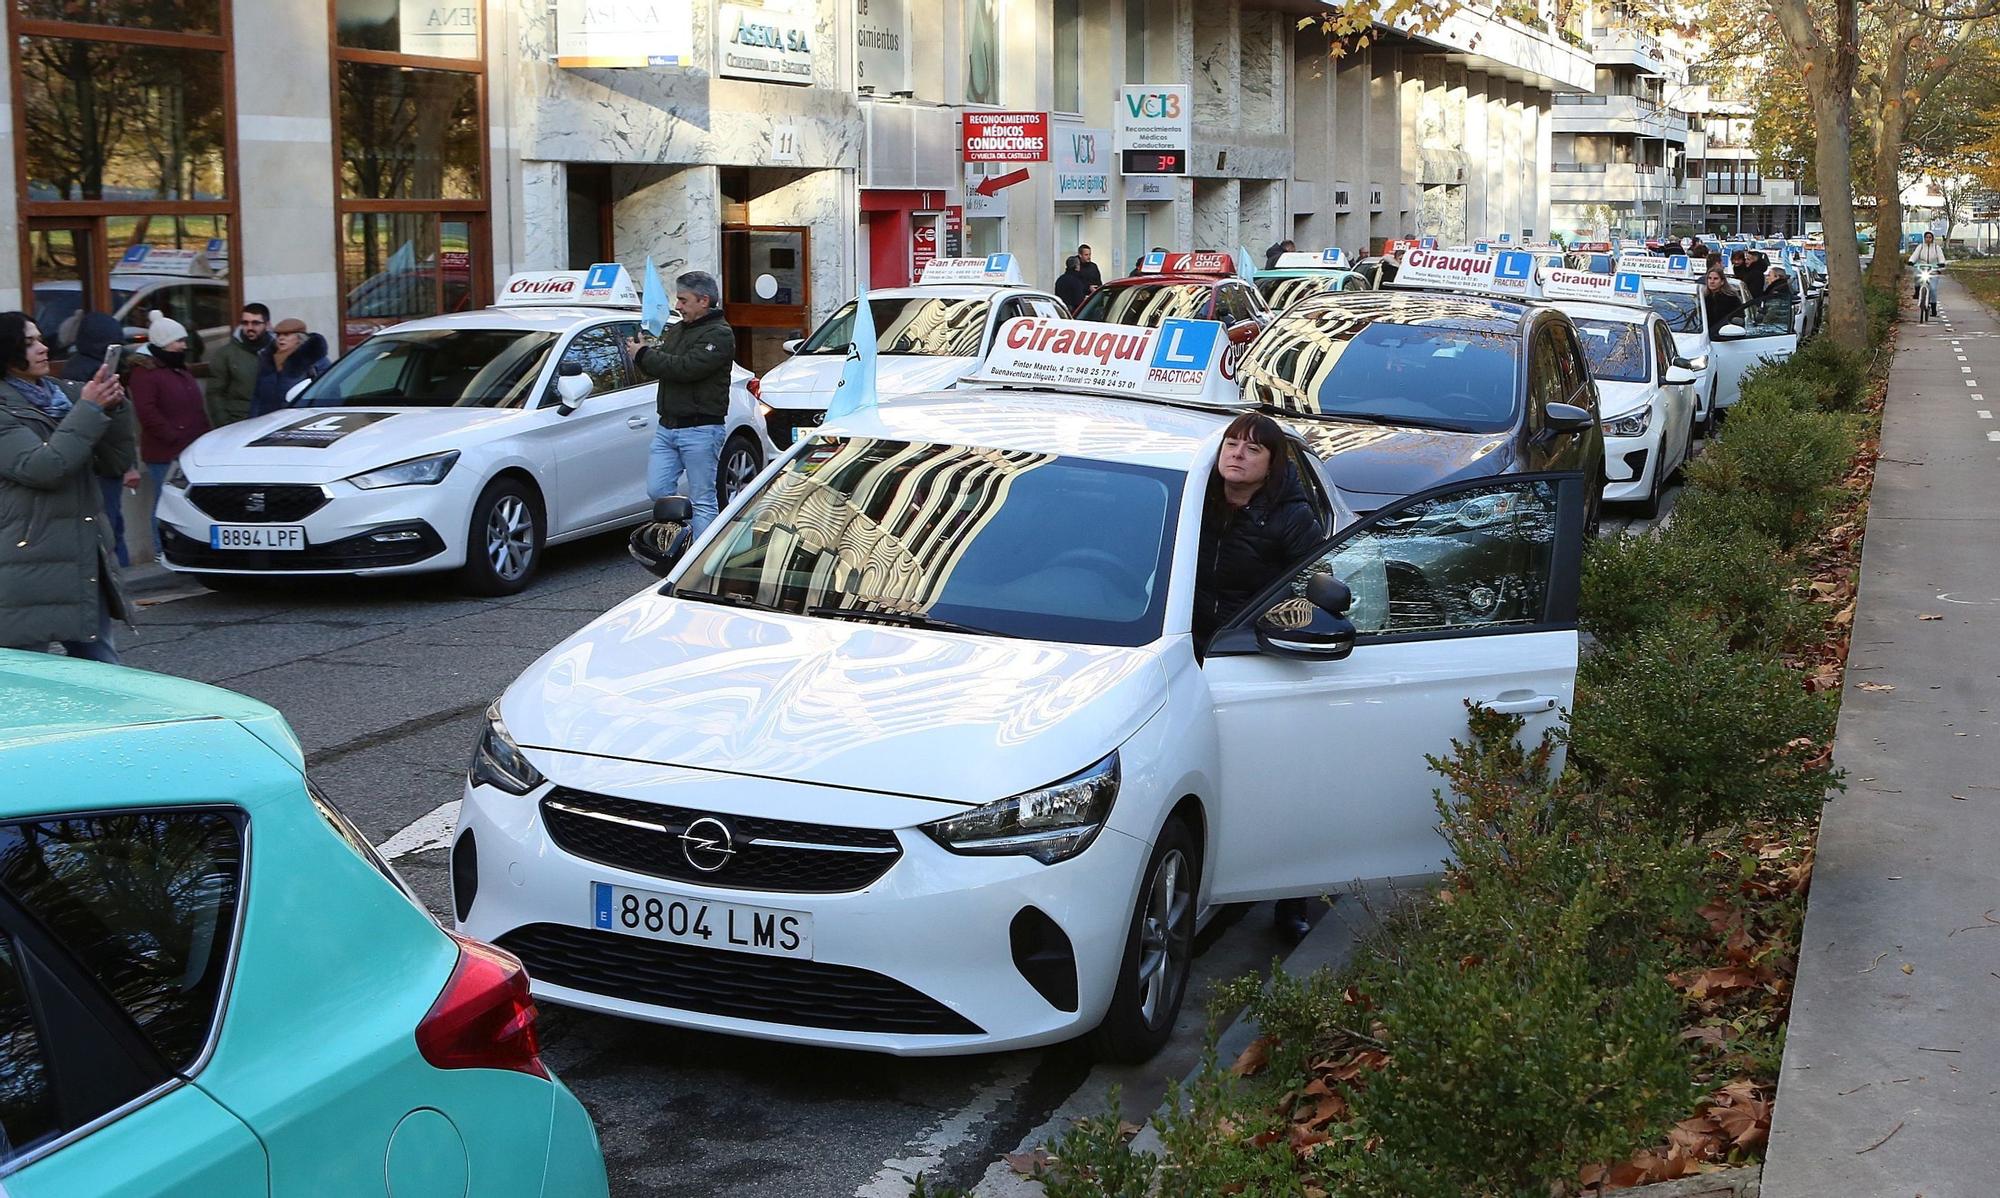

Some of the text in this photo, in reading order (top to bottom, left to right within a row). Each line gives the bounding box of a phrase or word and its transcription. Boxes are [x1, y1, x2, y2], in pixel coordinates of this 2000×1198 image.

[787, 29, 810, 53] SA
[1126, 93, 1181, 118] VC13
[969, 115, 1040, 124] RECONOCIMIENTOS
[983, 124, 1024, 137] MÉDICOS
[780, 133, 793, 154] 11
[967, 136, 1044, 150] CONDUCTORES
[1007, 152, 1032, 160] CASTILLO
[922, 192, 931, 210] 11
[929, 259, 948, 267] San
[990, 256, 1002, 270] L
[1149, 255, 1158, 265] L
[1409, 250, 1493, 276] Cirauqui
[1503, 256, 1521, 276] L
[1672, 257, 1682, 269] L
[510, 269, 607, 293] Orvina L
[1493, 278, 1526, 288] PRACTICAS
[1551, 272, 1612, 289] Cirauqui
[1621, 276, 1633, 290] L
[1006, 319, 1195, 366] Cirauqui L
[1013, 360, 1032, 369] Pintor
[1075, 367, 1088, 375] 948
[1090, 368, 1099, 376] 25
[1148, 368, 1203, 384] PRACTICAS
[990, 366, 1032, 379] Buenaventura
[1092, 378, 1105, 386] 948
[1117, 380, 1127, 388] 57
[222, 529, 299, 547] 8894 LPF
[600, 911, 607, 921] E
[620, 894, 800, 951] 8804 LMS
